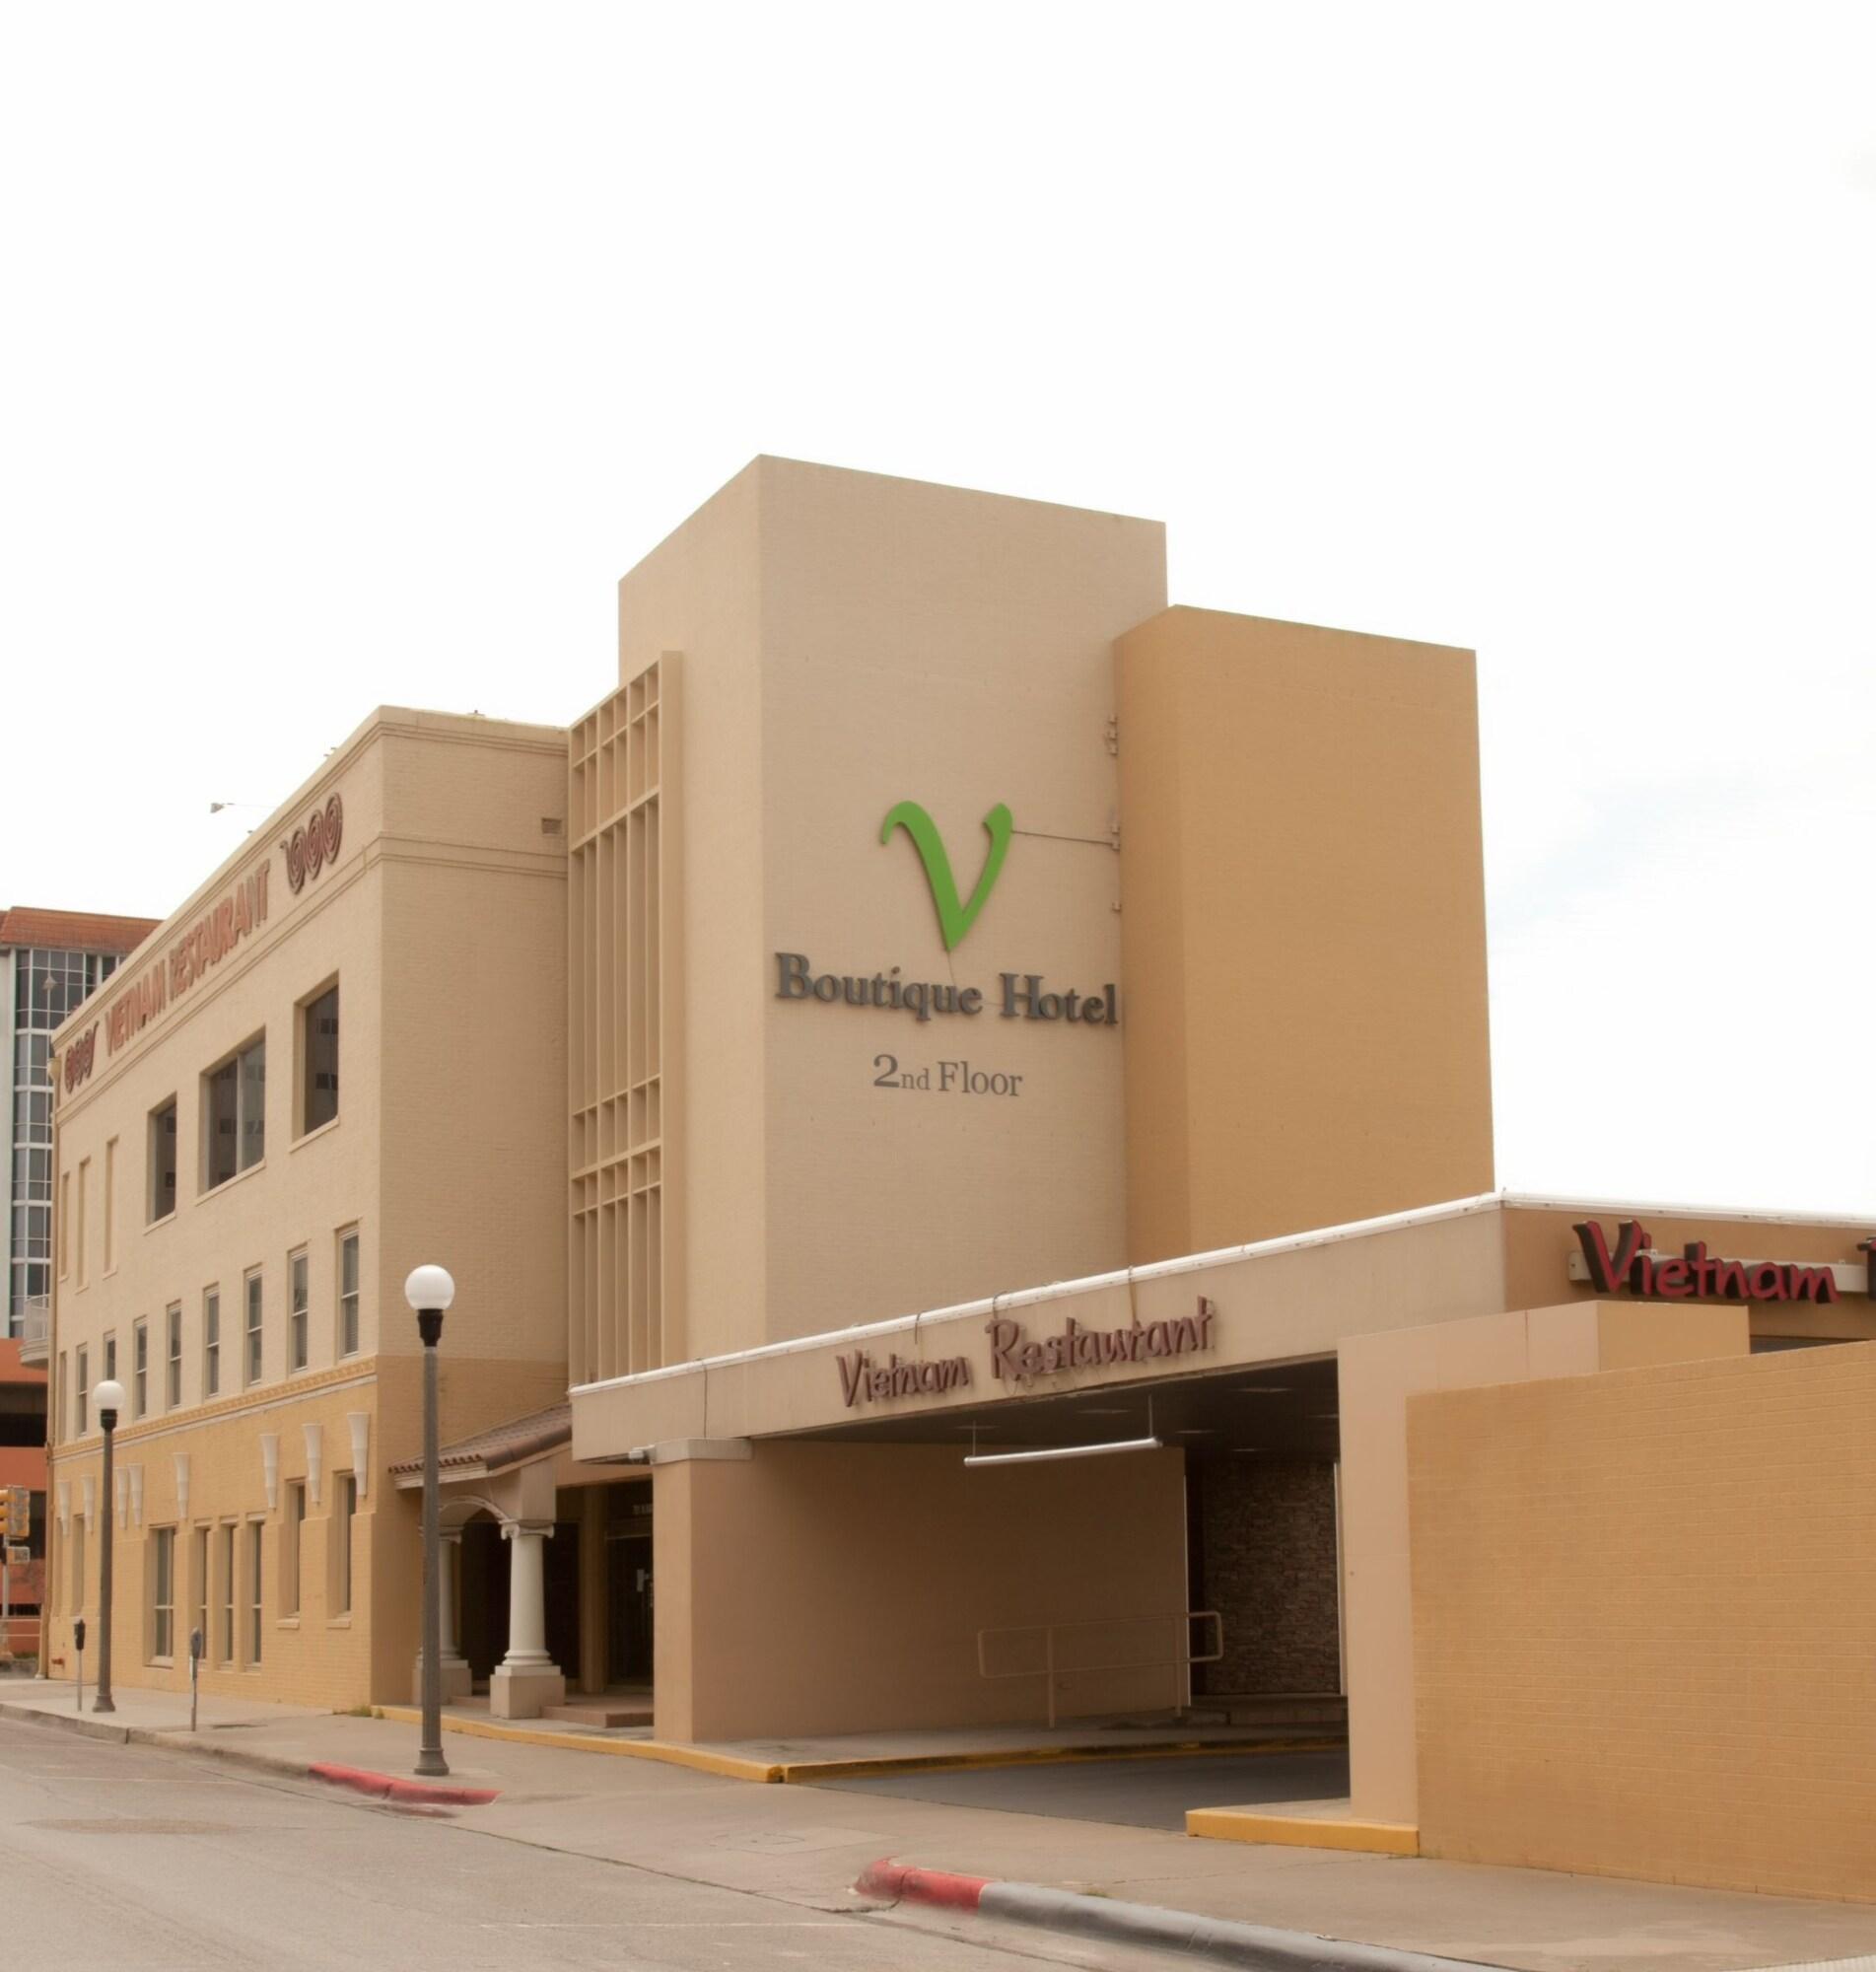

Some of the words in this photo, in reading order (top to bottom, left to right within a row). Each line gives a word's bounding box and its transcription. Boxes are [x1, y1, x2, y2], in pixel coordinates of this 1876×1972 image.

[880, 800, 1013, 953] V
[104, 958, 166, 1057] VIETNAM
[169, 858, 270, 1002] RESTAURANT
[775, 951, 983, 1022] Boutique
[1000, 972, 1118, 1025] Hotel
[872, 1053, 930, 1091] 2nd
[938, 1061, 1023, 1096] Floor
[1572, 1219, 1841, 1303] Vietnam
[836, 1349, 972, 1407] Vietnam
[984, 1295, 1216, 1382] Restaurant
